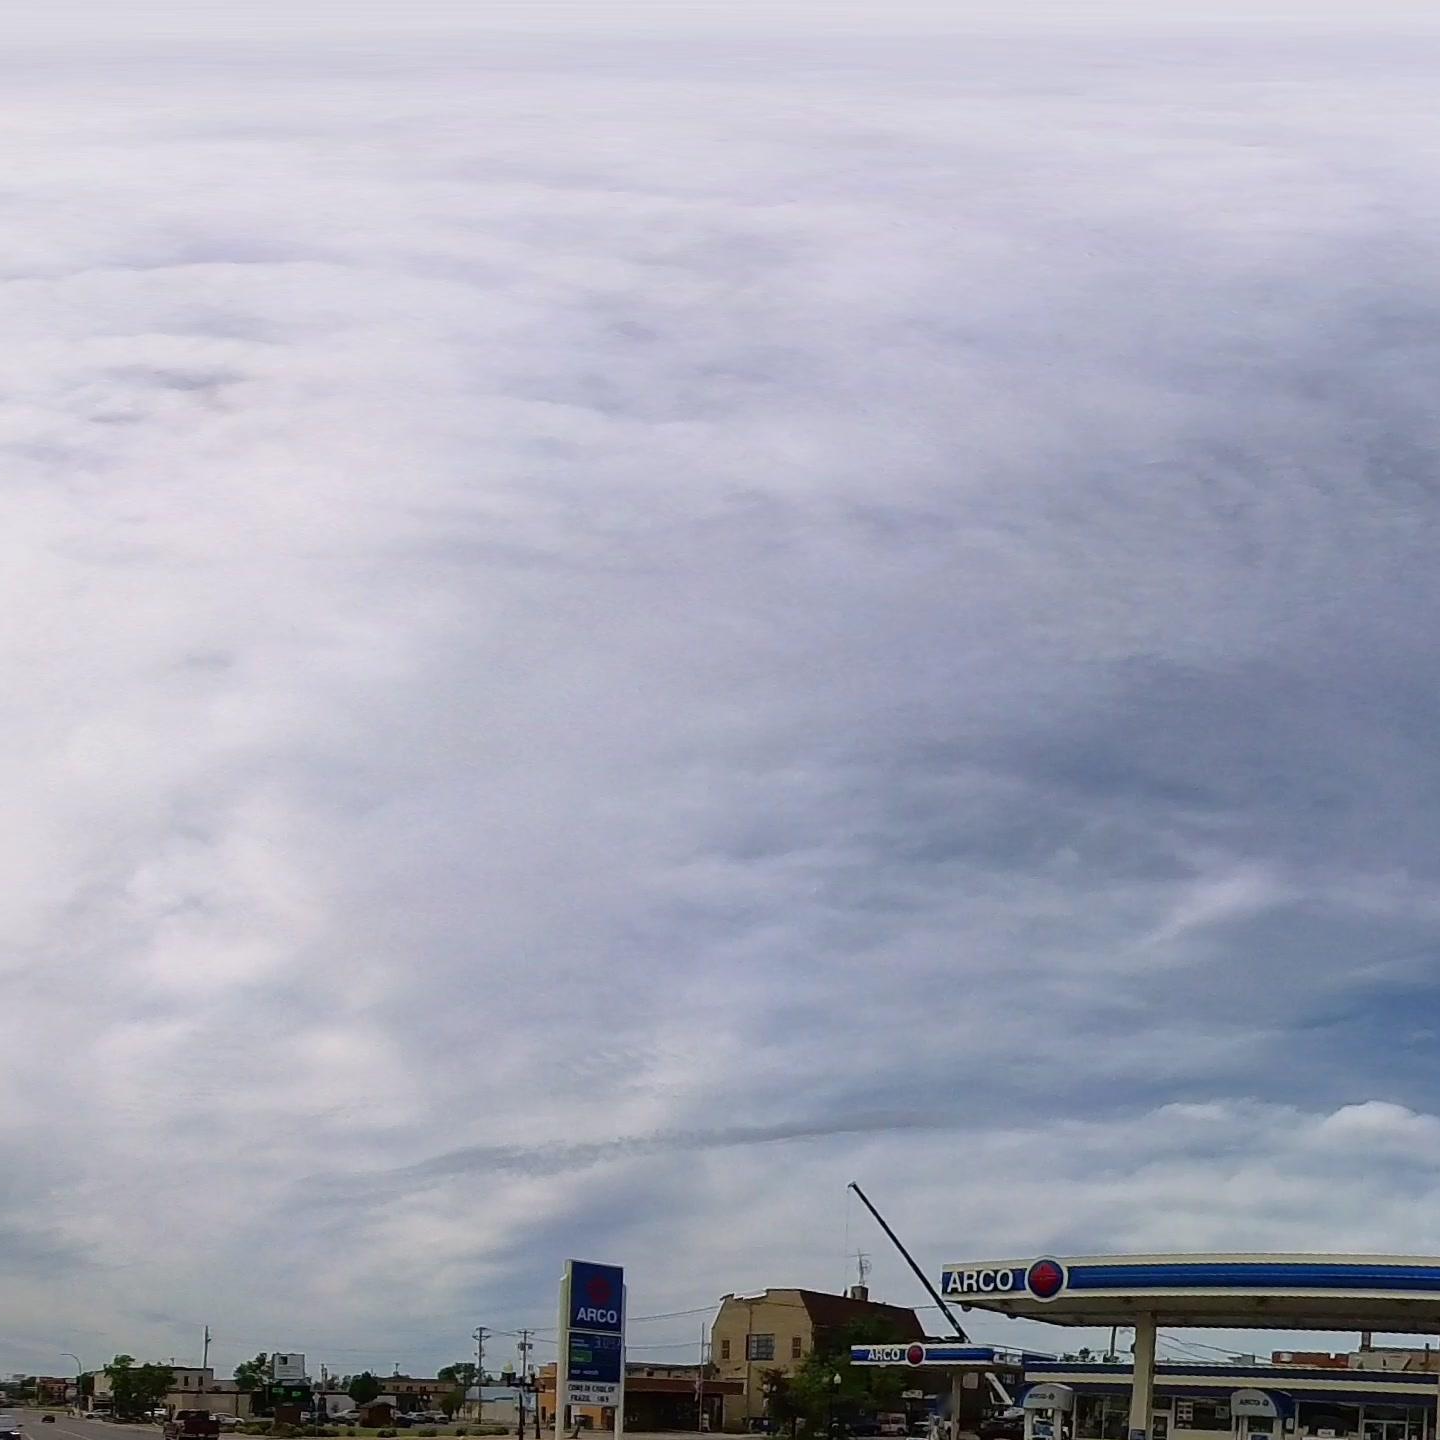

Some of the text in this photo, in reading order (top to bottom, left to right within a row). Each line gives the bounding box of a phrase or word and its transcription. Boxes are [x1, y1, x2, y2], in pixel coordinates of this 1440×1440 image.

[946, 1269, 1013, 1293] ARCO
[576, 1307, 618, 1324] ARCO
[867, 1348, 901, 1361] ARCO
